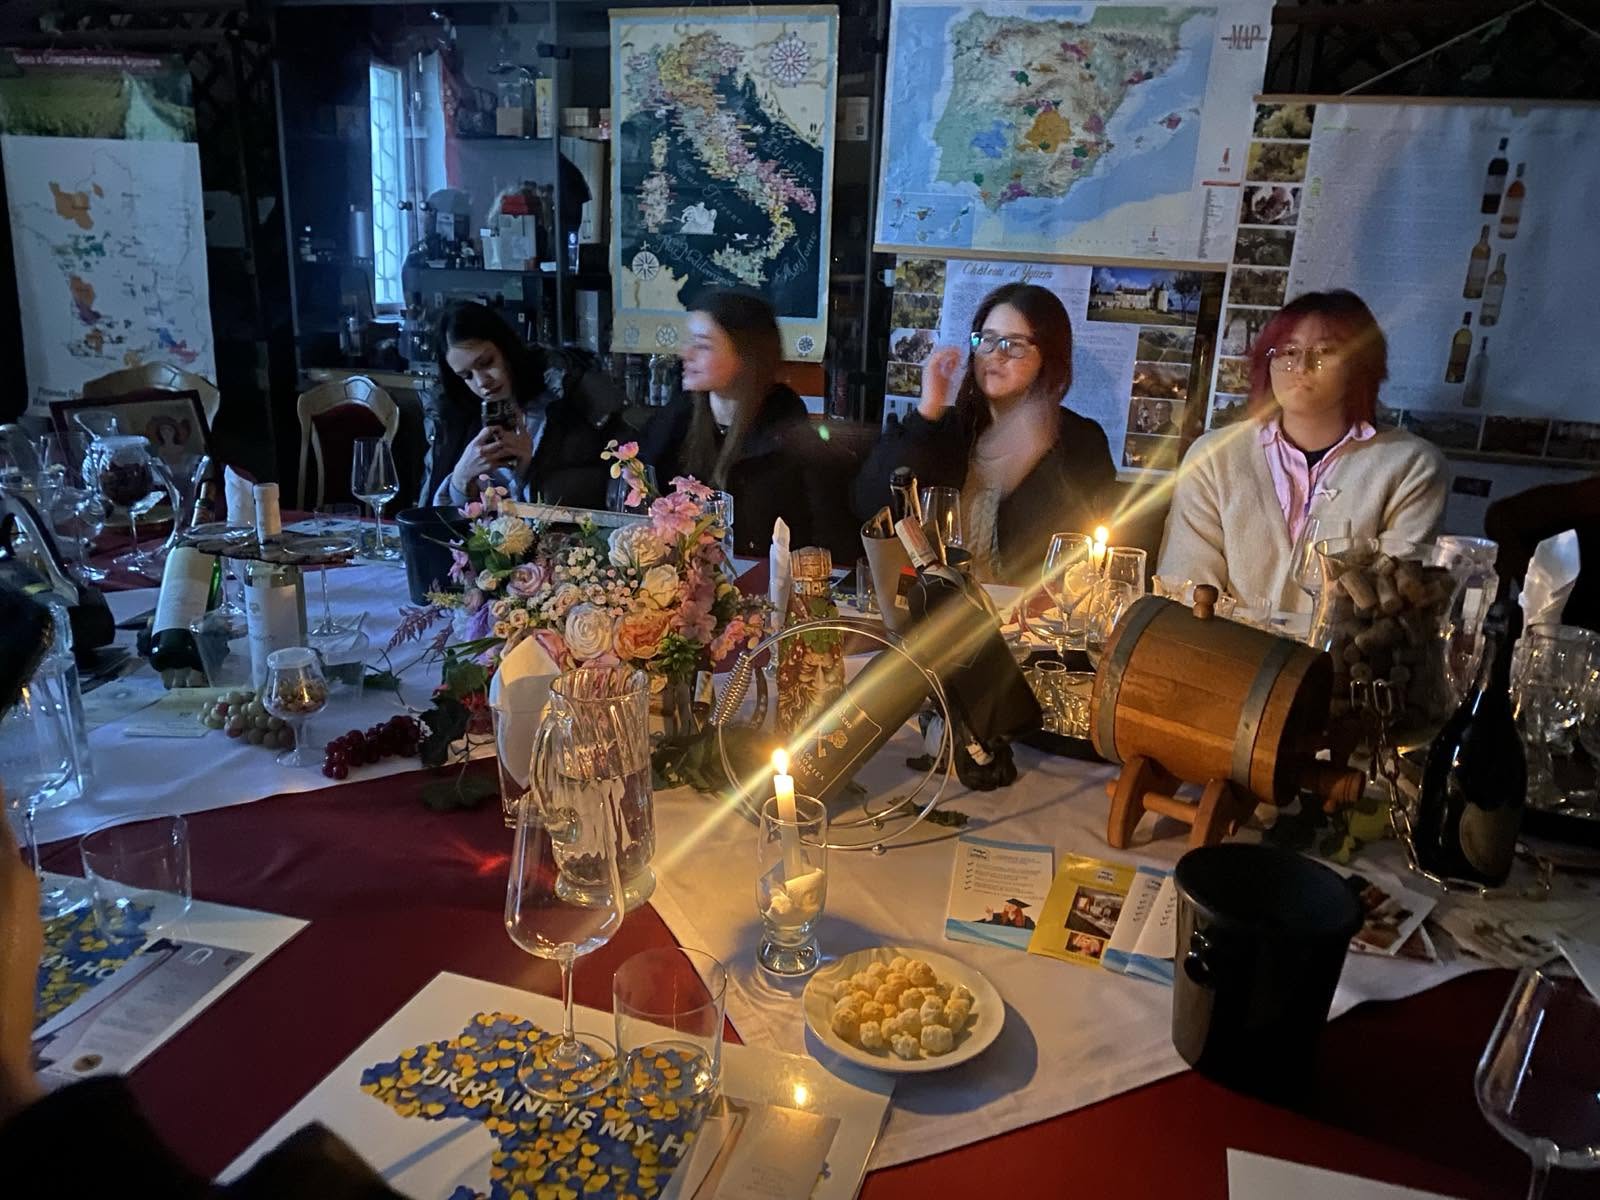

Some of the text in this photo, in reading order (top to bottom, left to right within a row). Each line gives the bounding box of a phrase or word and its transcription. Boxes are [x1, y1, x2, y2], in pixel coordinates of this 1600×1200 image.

[72, 960, 120, 980] HO
[420, 1066, 564, 1120] UKRAINE
[562, 1106, 599, 1131] IS
[598, 1120, 656, 1147] MY
